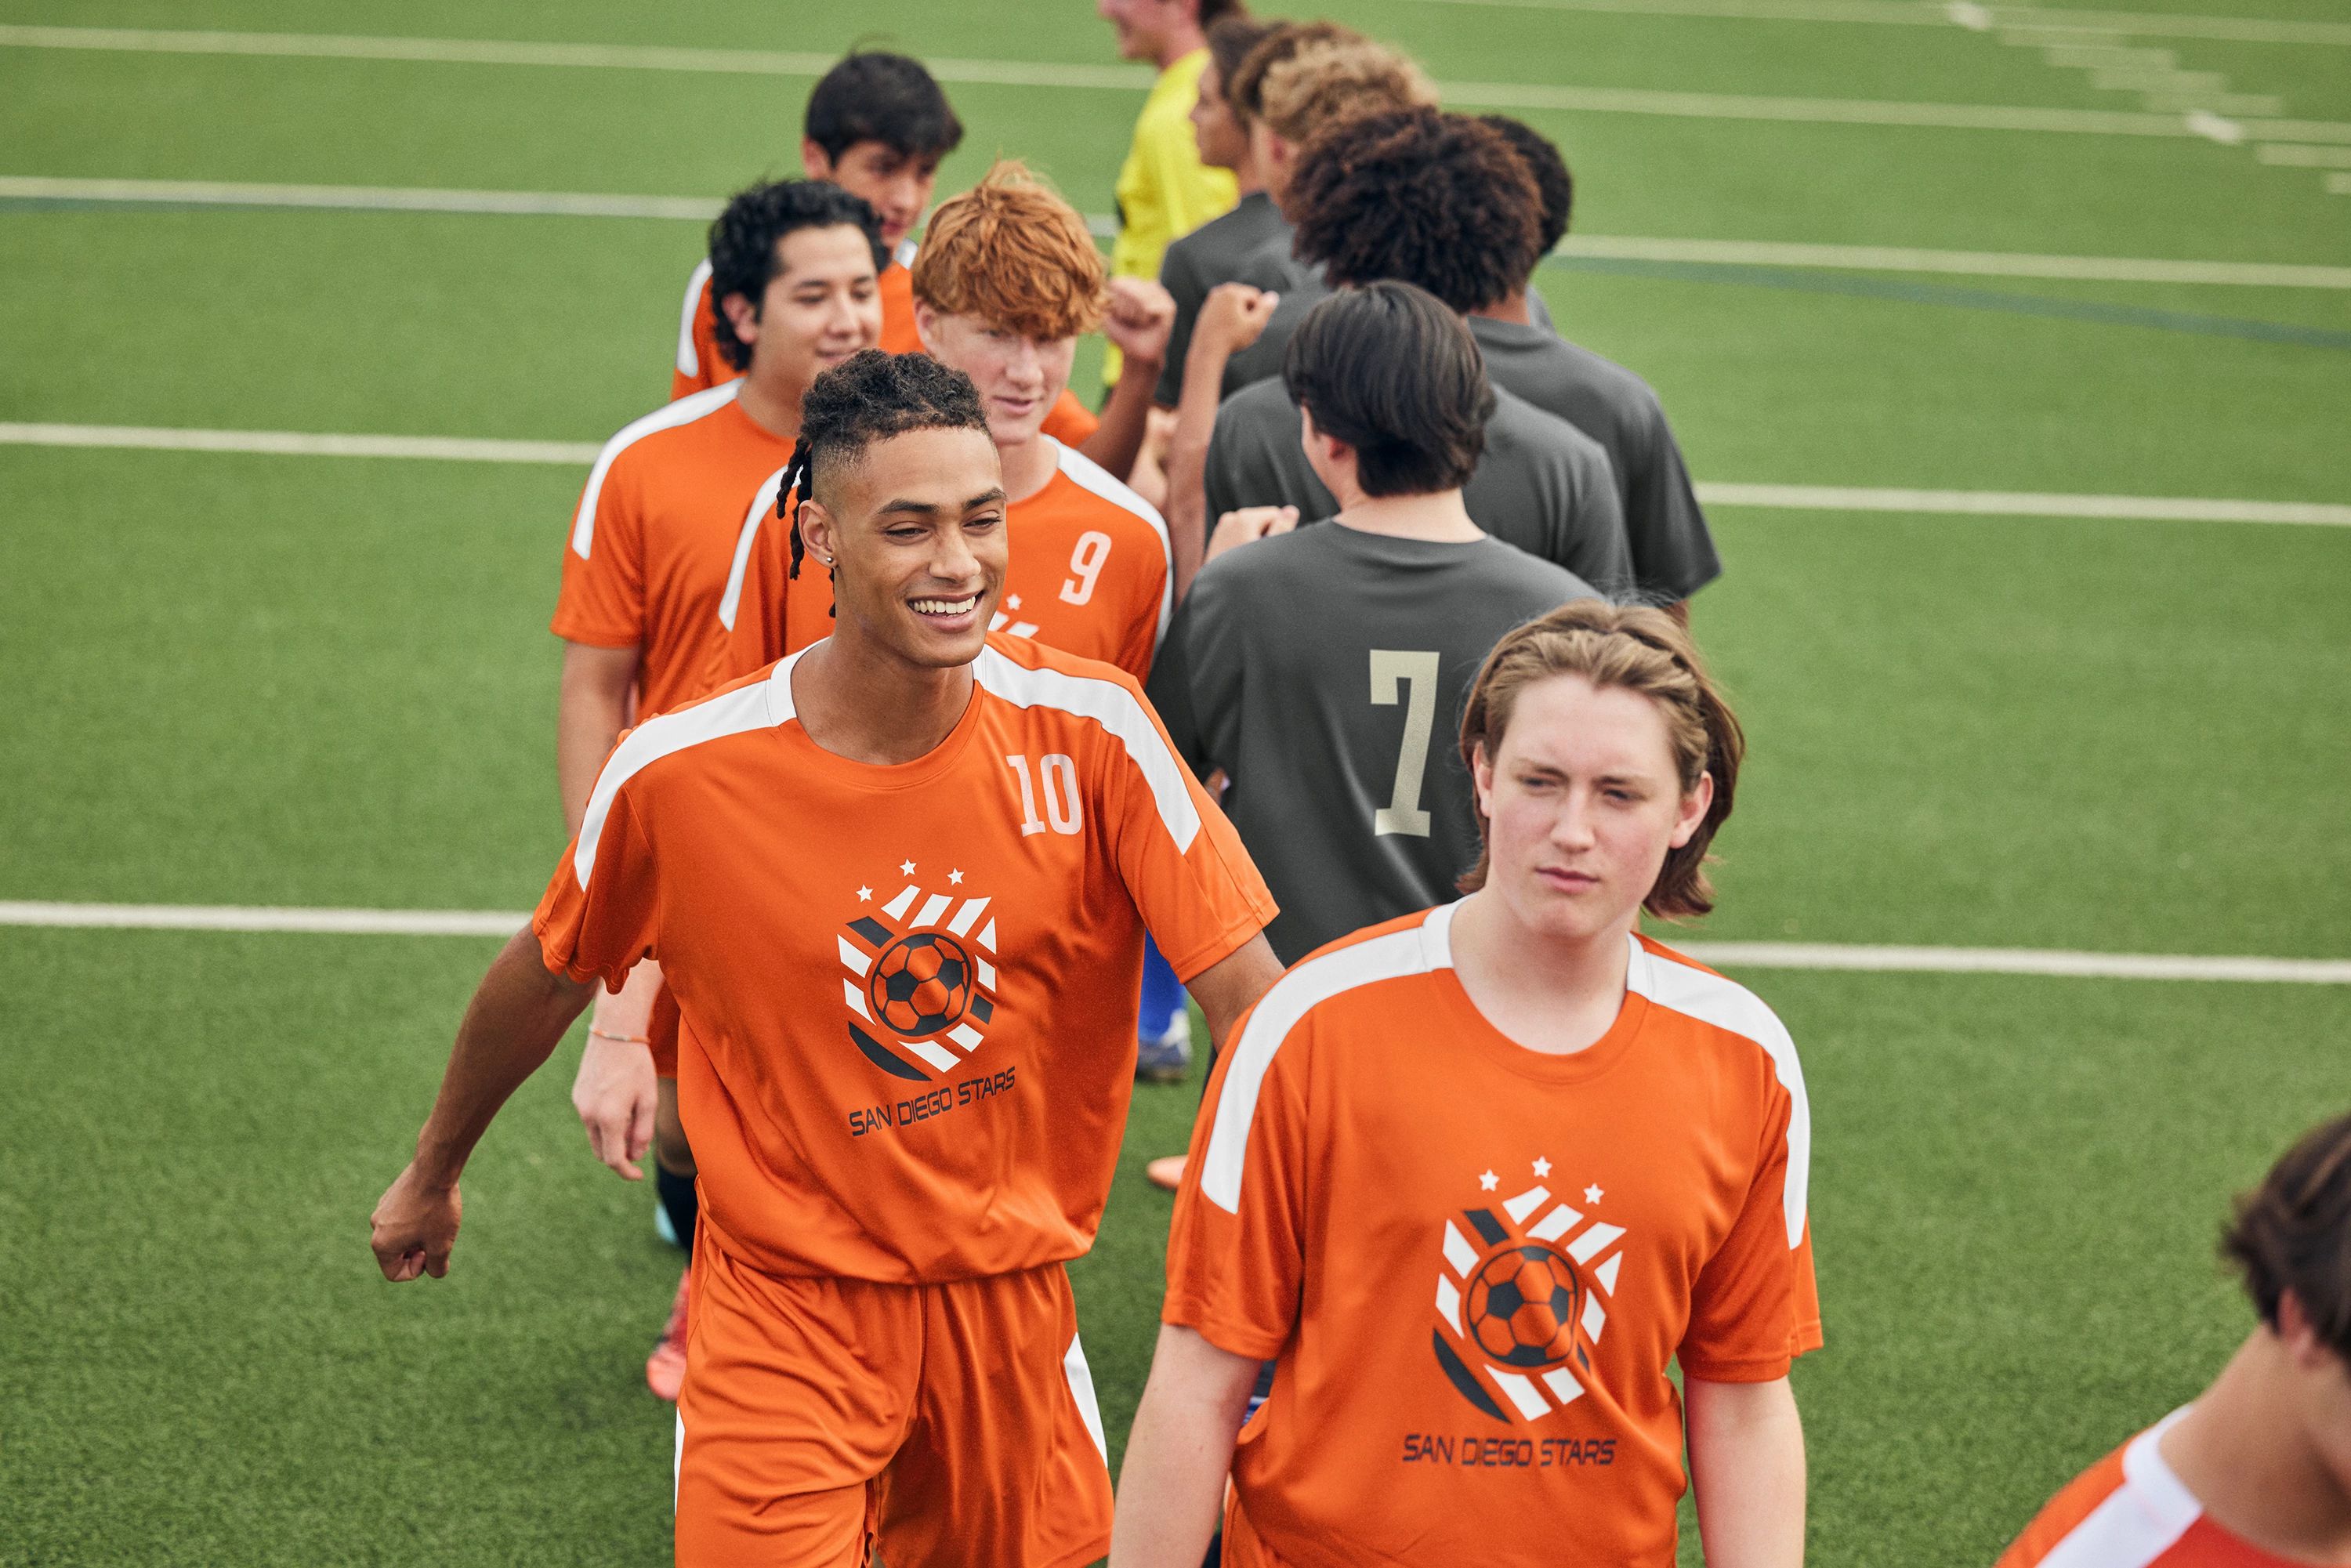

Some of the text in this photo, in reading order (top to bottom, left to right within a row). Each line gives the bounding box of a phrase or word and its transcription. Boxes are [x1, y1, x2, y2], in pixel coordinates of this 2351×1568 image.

[1059, 531, 1112, 606] 9
[1369, 649, 1440, 838] 7
[1006, 753, 1082, 837] 10
[849, 1066, 1016, 1137] SAN DIEGO STARS
[1402, 1434, 1617, 1467] SAN DIEGO STARS
